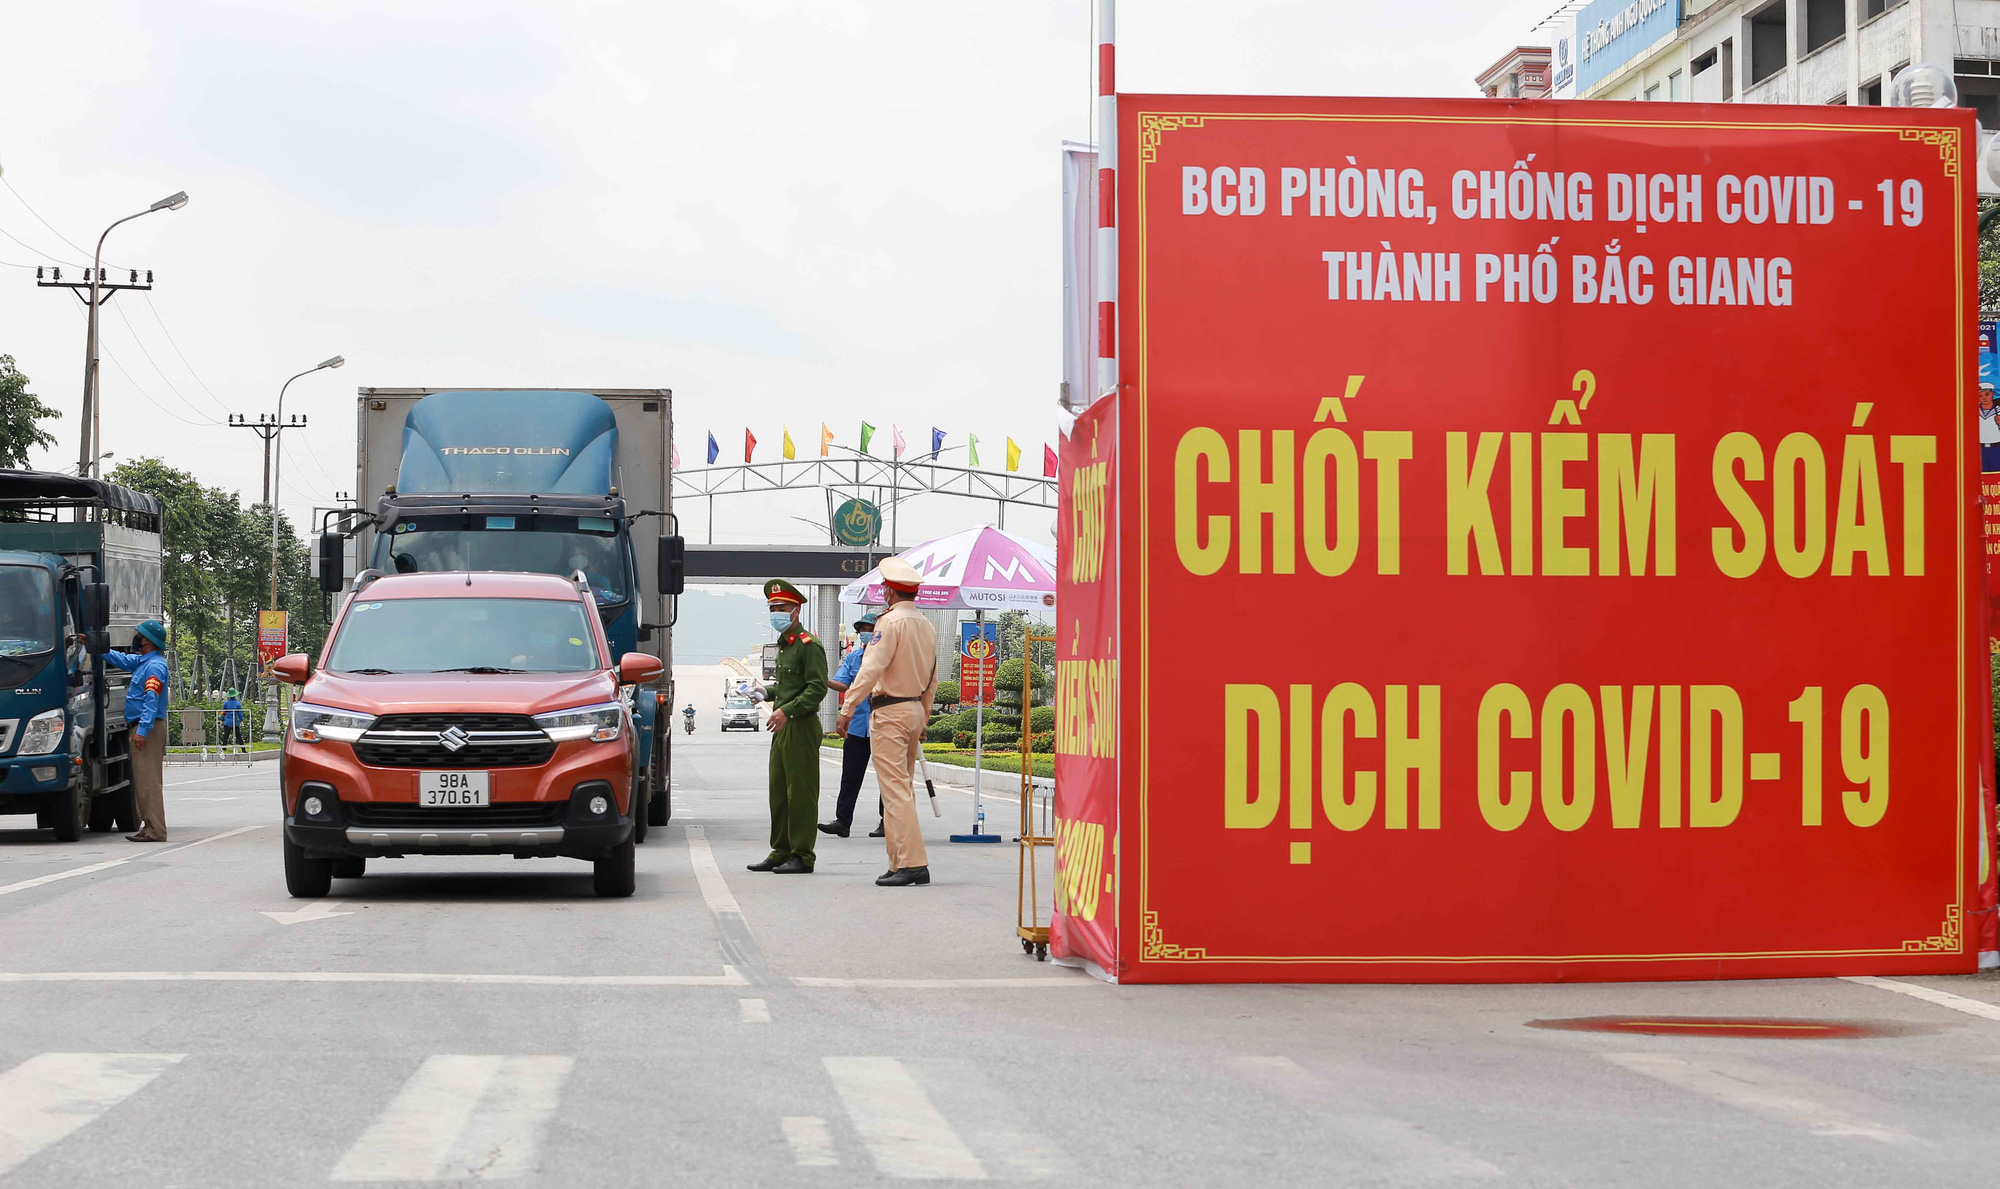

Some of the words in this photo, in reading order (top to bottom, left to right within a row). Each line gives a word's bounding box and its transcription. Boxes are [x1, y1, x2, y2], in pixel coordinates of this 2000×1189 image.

[1182, 166, 1265, 216] BCĐ
[1281, 156, 1436, 224] PHÒNG,
[1452, 154, 1592, 221] CHỐNG
[1608, 173, 1702, 233] DỊCH
[1717, 175, 1834, 224] COVID
[1878, 179, 1922, 226] 19
[1322, 241, 1460, 301] THÀNH
[1476, 237, 1559, 303] PHỐ
[1573, 239, 1653, 304] BẮC
[1669, 256, 1792, 306] GIANG
[441, 447, 511, 455] THACO
[514, 447, 570, 457] OLLIN
[1175, 375, 1413, 576] CHỐT
[1446, 370, 1676, 576] KIỂM
[1712, 403, 1936, 578] SOÁT
[1073, 419, 1107, 585] CHỐT
[969, 592, 1006, 602] MUTOSI
[428, 790, 479, 804] 370.61
[440, 774, 468, 788] 98A
[1225, 682, 1440, 865] DỊCH
[1478, 683, 1890, 831] COVID-19
